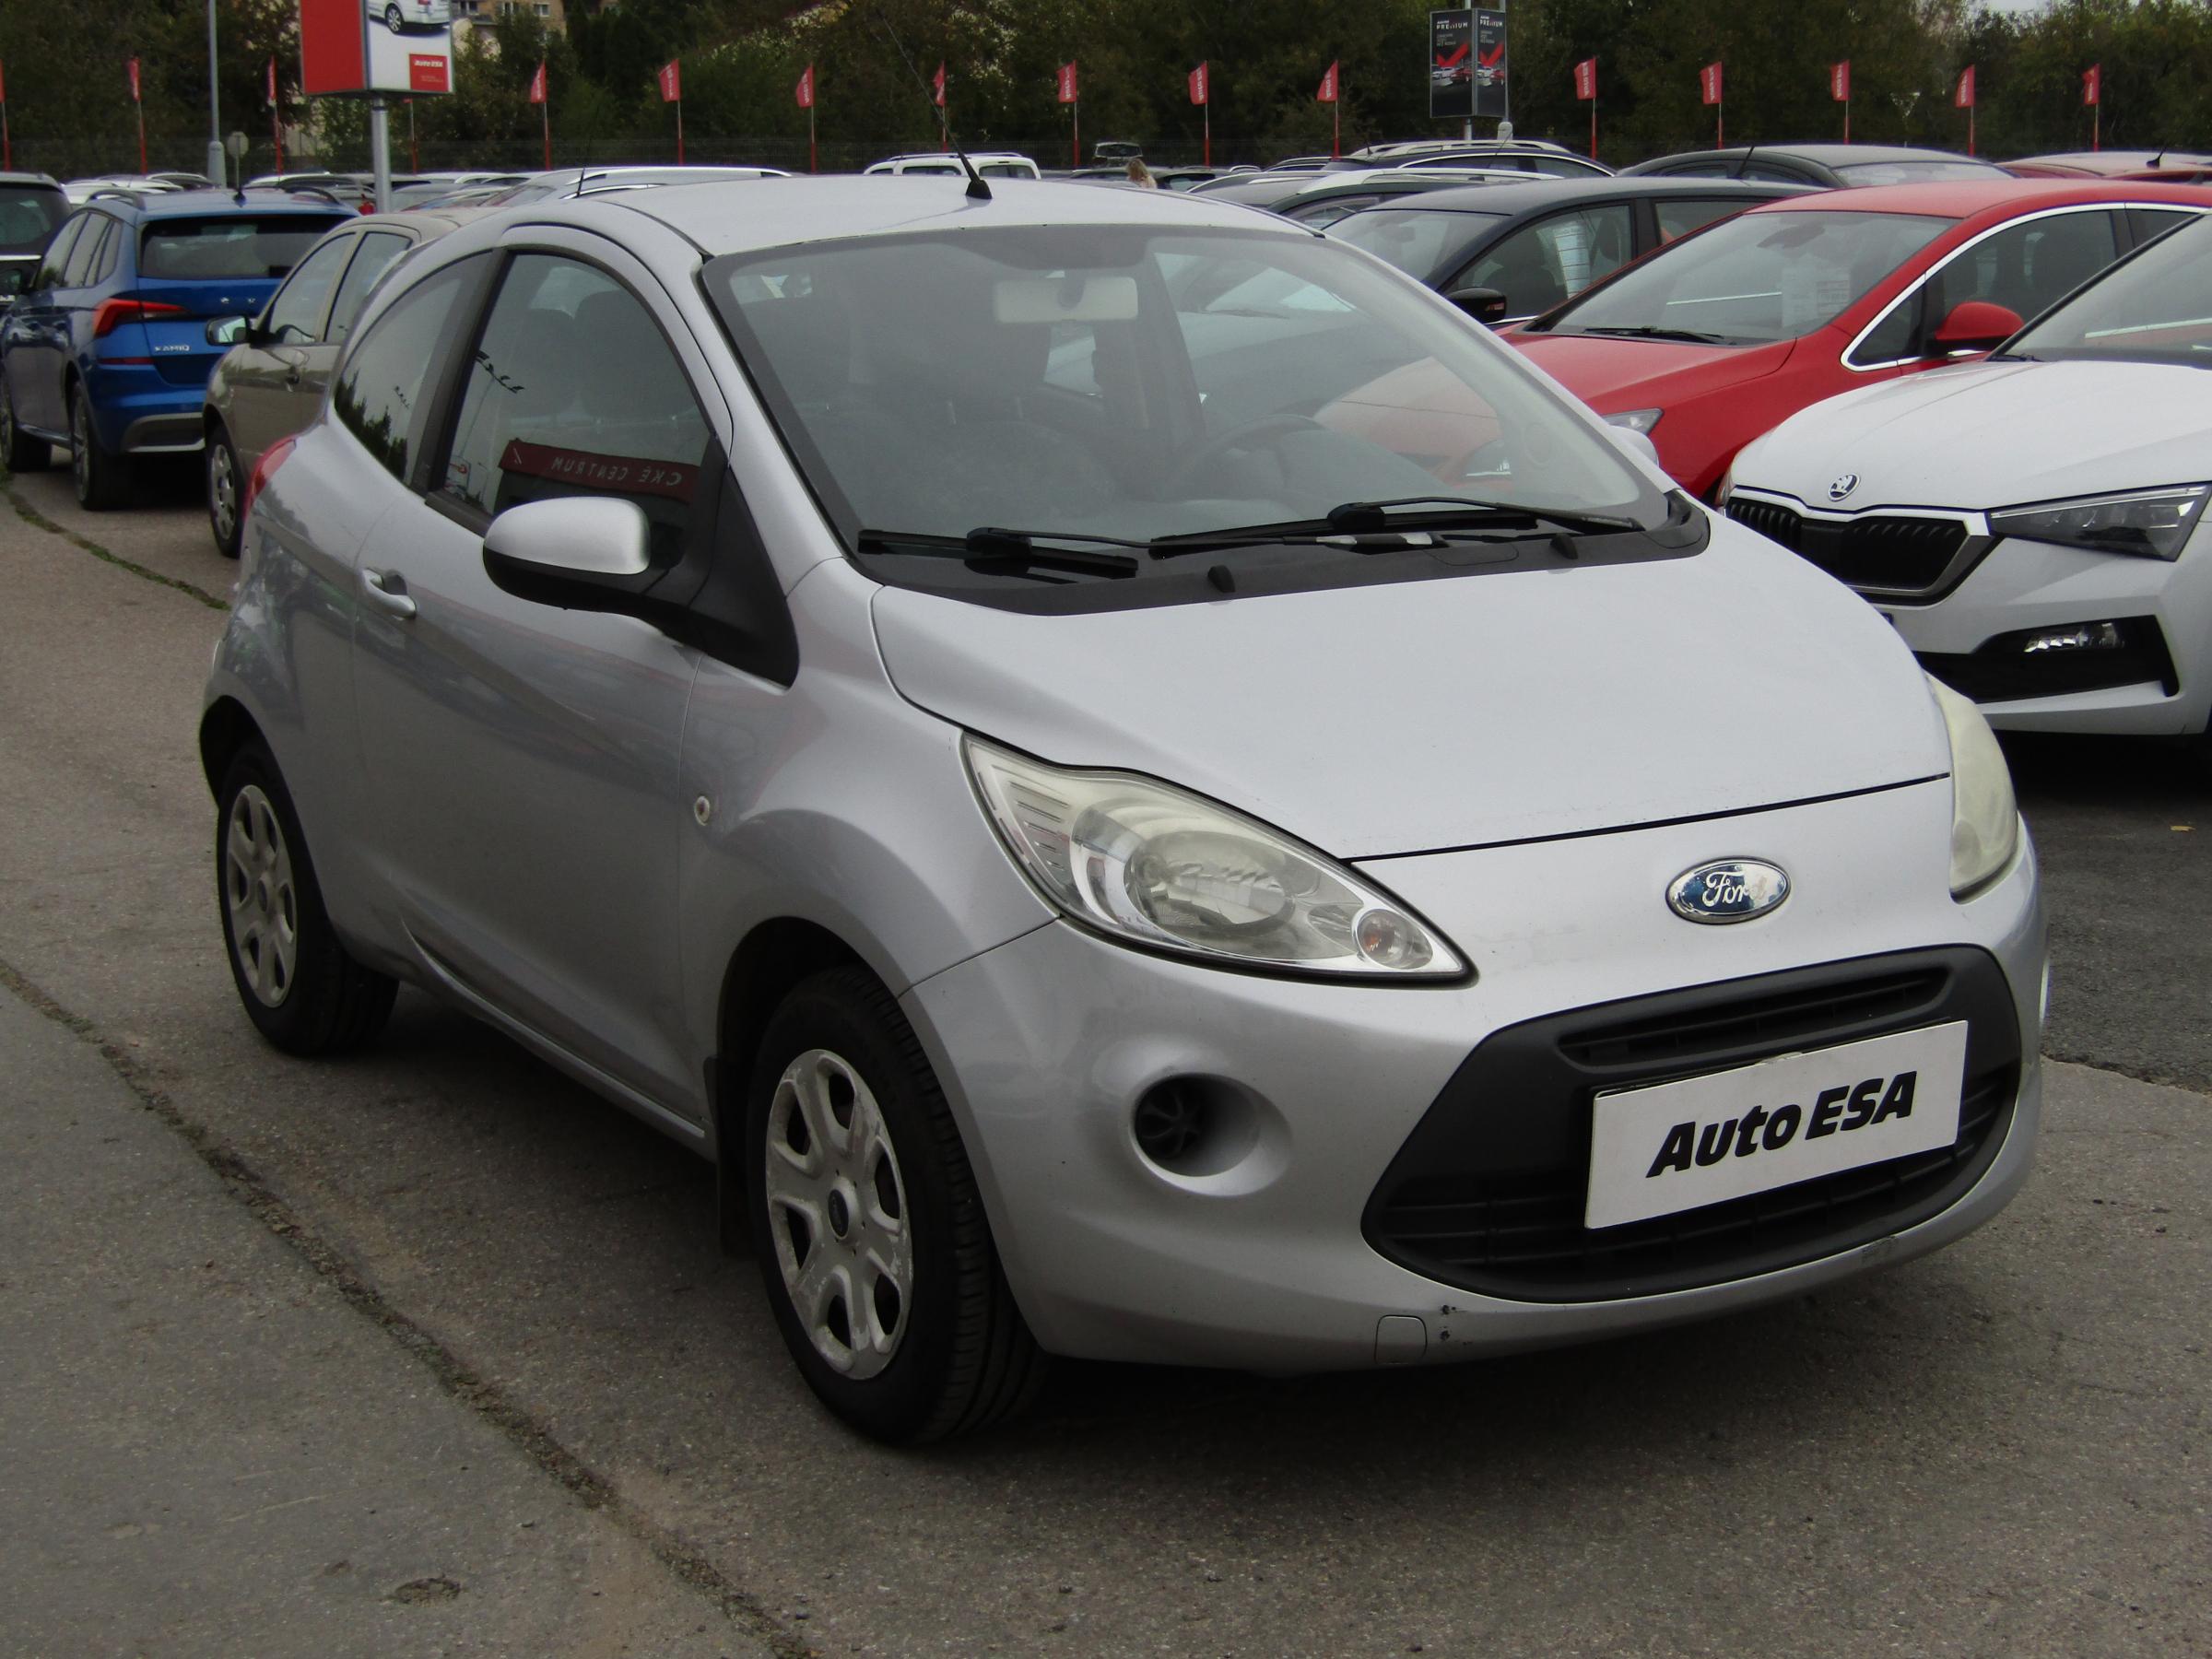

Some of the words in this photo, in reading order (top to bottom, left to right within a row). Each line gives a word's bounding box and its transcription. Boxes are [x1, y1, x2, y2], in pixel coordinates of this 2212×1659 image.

[1701, 871, 1757, 908] For
[1645, 1103, 1802, 1179] Auto
[1805, 1070, 1918, 1141] ESA
